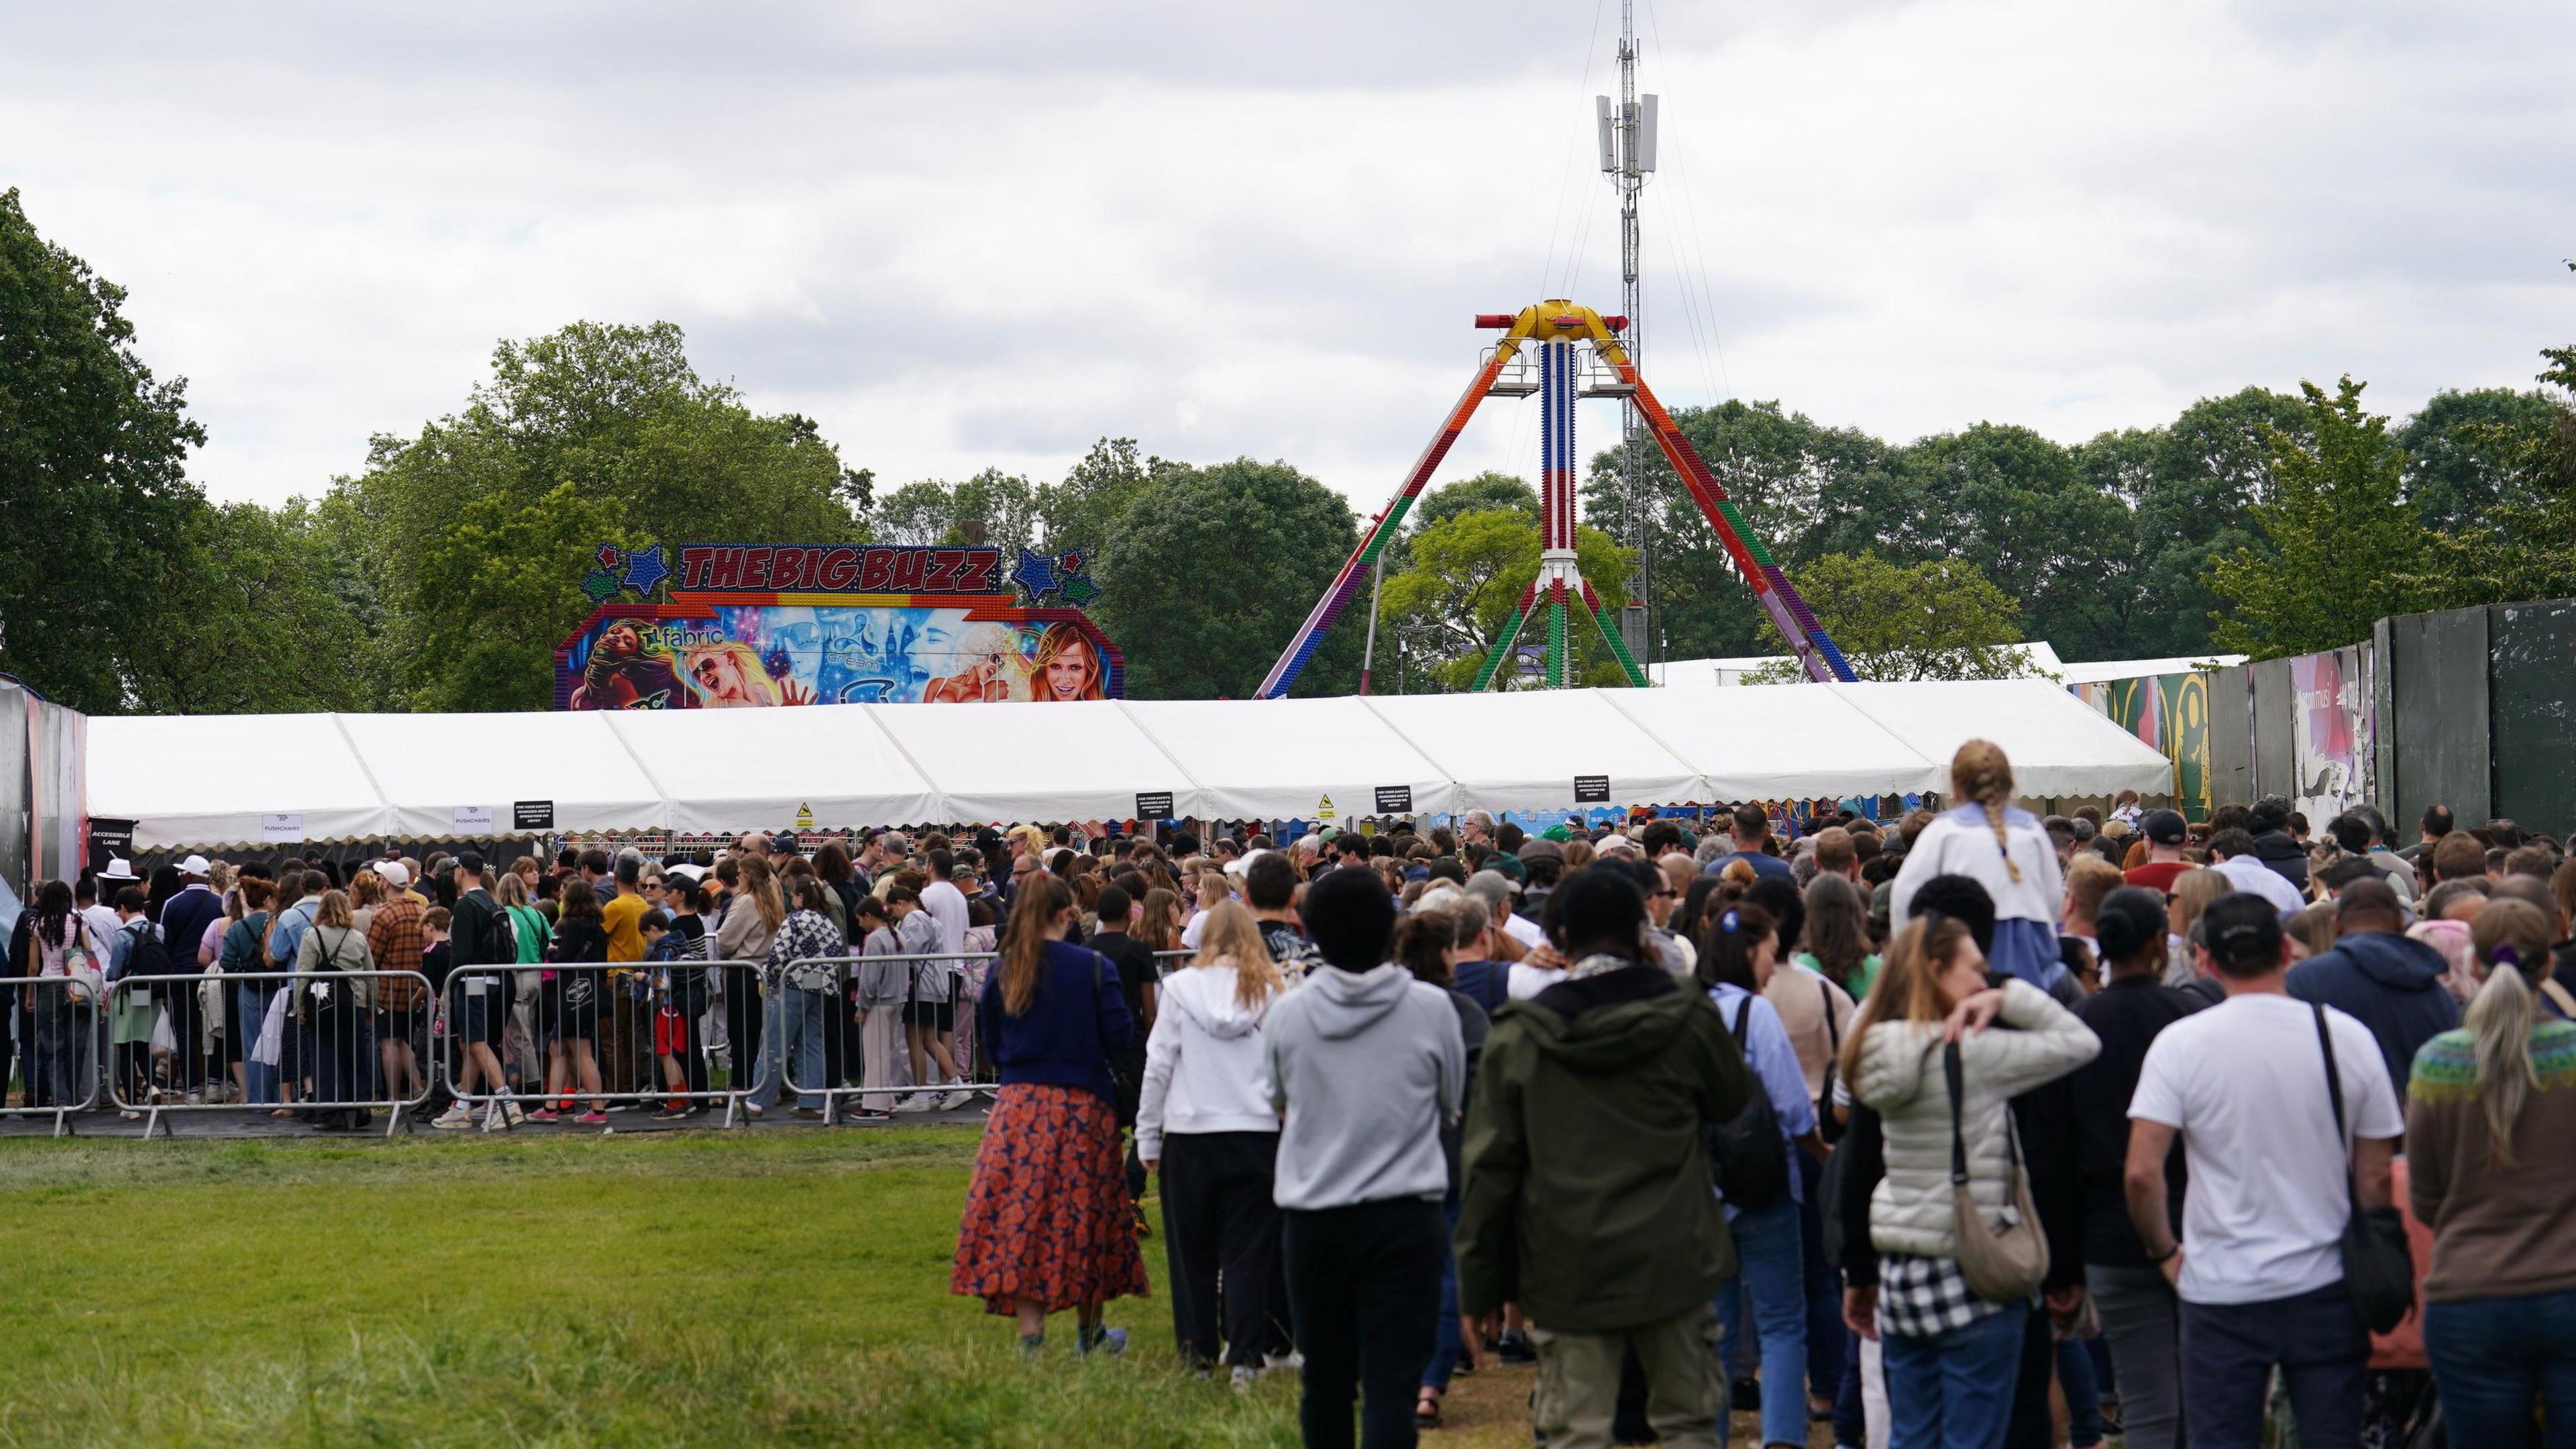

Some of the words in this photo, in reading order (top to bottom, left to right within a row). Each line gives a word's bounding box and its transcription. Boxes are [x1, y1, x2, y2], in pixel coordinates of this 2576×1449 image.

[683, 547, 772, 588] THE
[769, 547, 859, 590] BIG
[859, 548, 998, 591] BUZZ
[662, 625, 723, 647] fabric
[828, 653, 879, 669] cream
